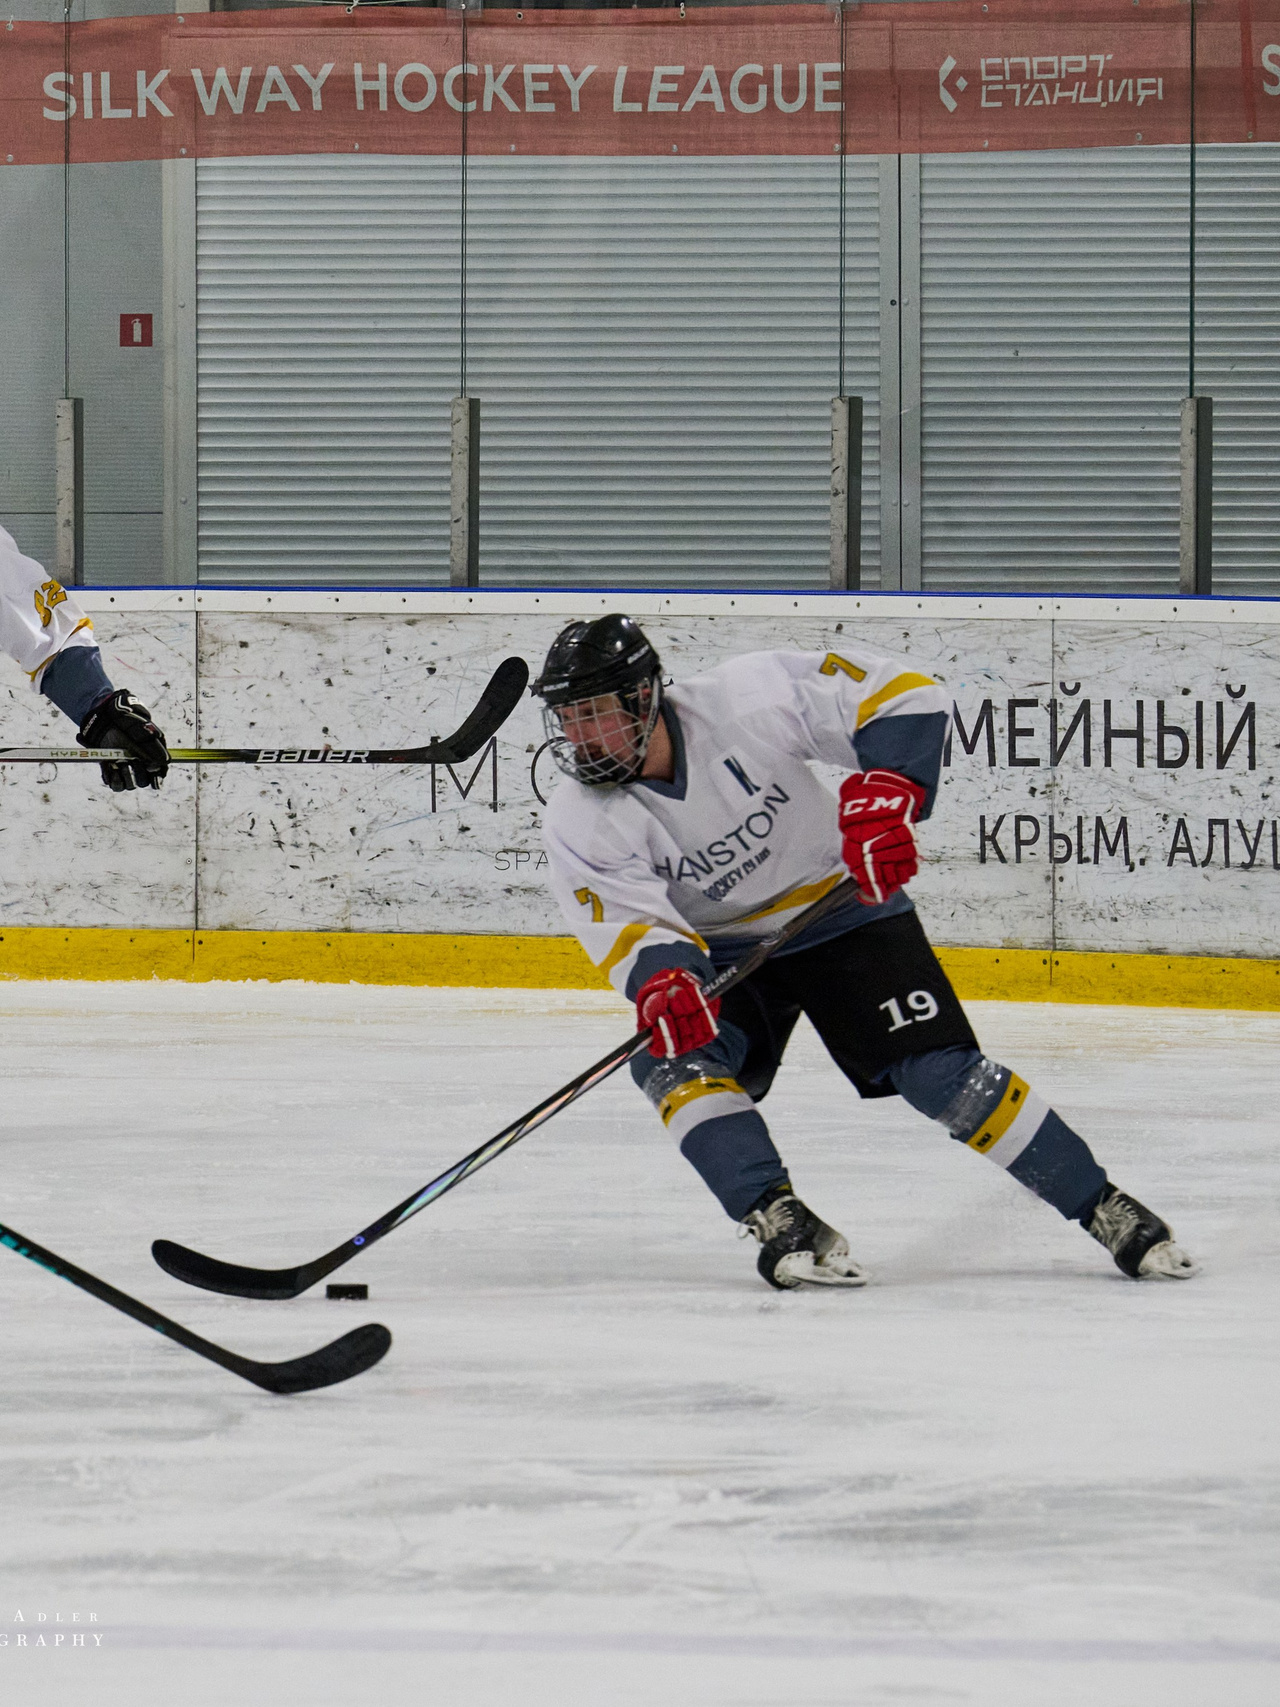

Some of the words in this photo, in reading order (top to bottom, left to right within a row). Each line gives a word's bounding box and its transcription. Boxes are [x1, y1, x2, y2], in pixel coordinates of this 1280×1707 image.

[980, 54, 1114, 81] СПОРТ
[42, 69, 175, 121] SILK
[190, 62, 336, 116] WAY
[352, 62, 598, 113] HOCKEY
[612, 62, 846, 114] LEAGUE
[980, 77, 1164, 108] СТАНЦИЯ
[818, 652, 868, 683] 7
[942, 681, 1256, 771] МЕЙНЫЙ
[50, 750, 123, 758] HYP2RLIT
[256, 749, 370, 763] BAUER
[654, 782, 791, 882] HANSTON
[1166, 817, 1280, 870] АЛУ
[573, 886, 605, 923] 7
[702, 965, 738, 995] AUER
[878, 989, 940, 1033] 19
